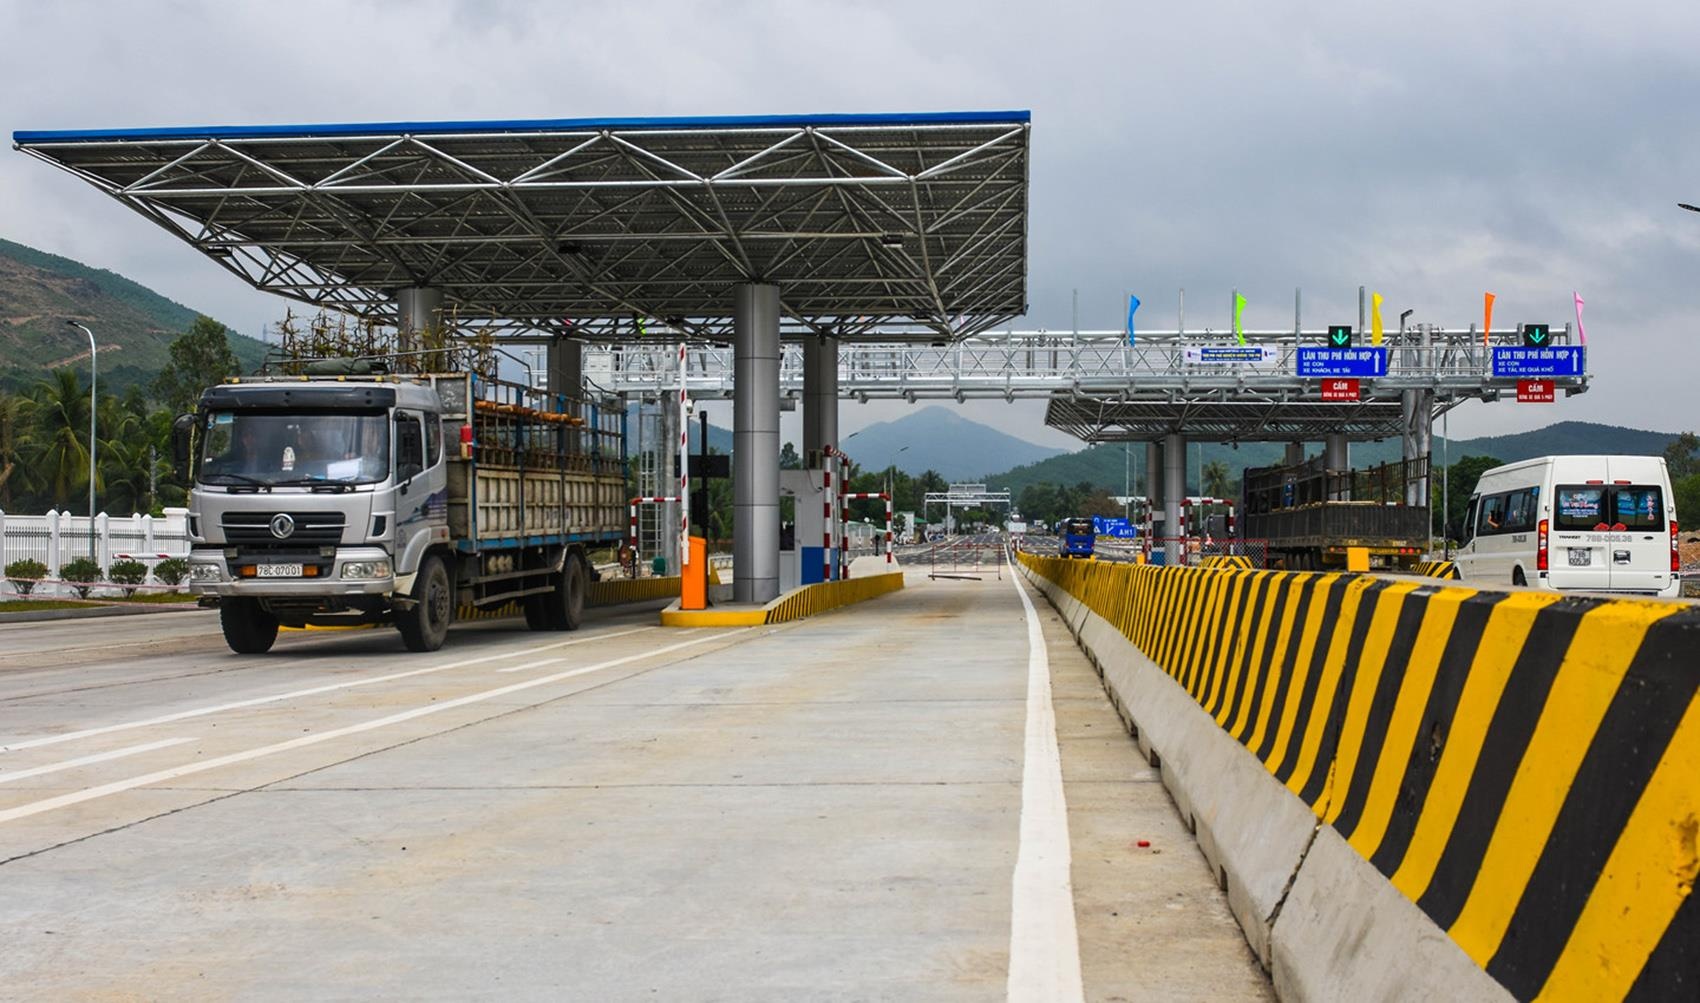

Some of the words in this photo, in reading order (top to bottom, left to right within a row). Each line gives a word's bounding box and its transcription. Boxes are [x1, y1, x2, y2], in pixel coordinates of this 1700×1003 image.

[1303, 350, 1315, 360] LÀN
[1318, 351, 1329, 360] THU
[1331, 350, 1342, 360] PHÍ
[1344, 349, 1357, 360] HỖN
[1359, 350, 1372, 361] HỢP
[1498, 349, 1511, 359] LÀN
[1513, 350, 1525, 359] THU
[1527, 349, 1539, 359] PHÍ
[1541, 348, 1554, 359] HỖN
[1556, 350, 1569, 360] HỢP
[1333, 380, 1348, 390] CẤM
[1528, 382, 1543, 392] CẤM
[1119, 528, 1133, 536] AH1
